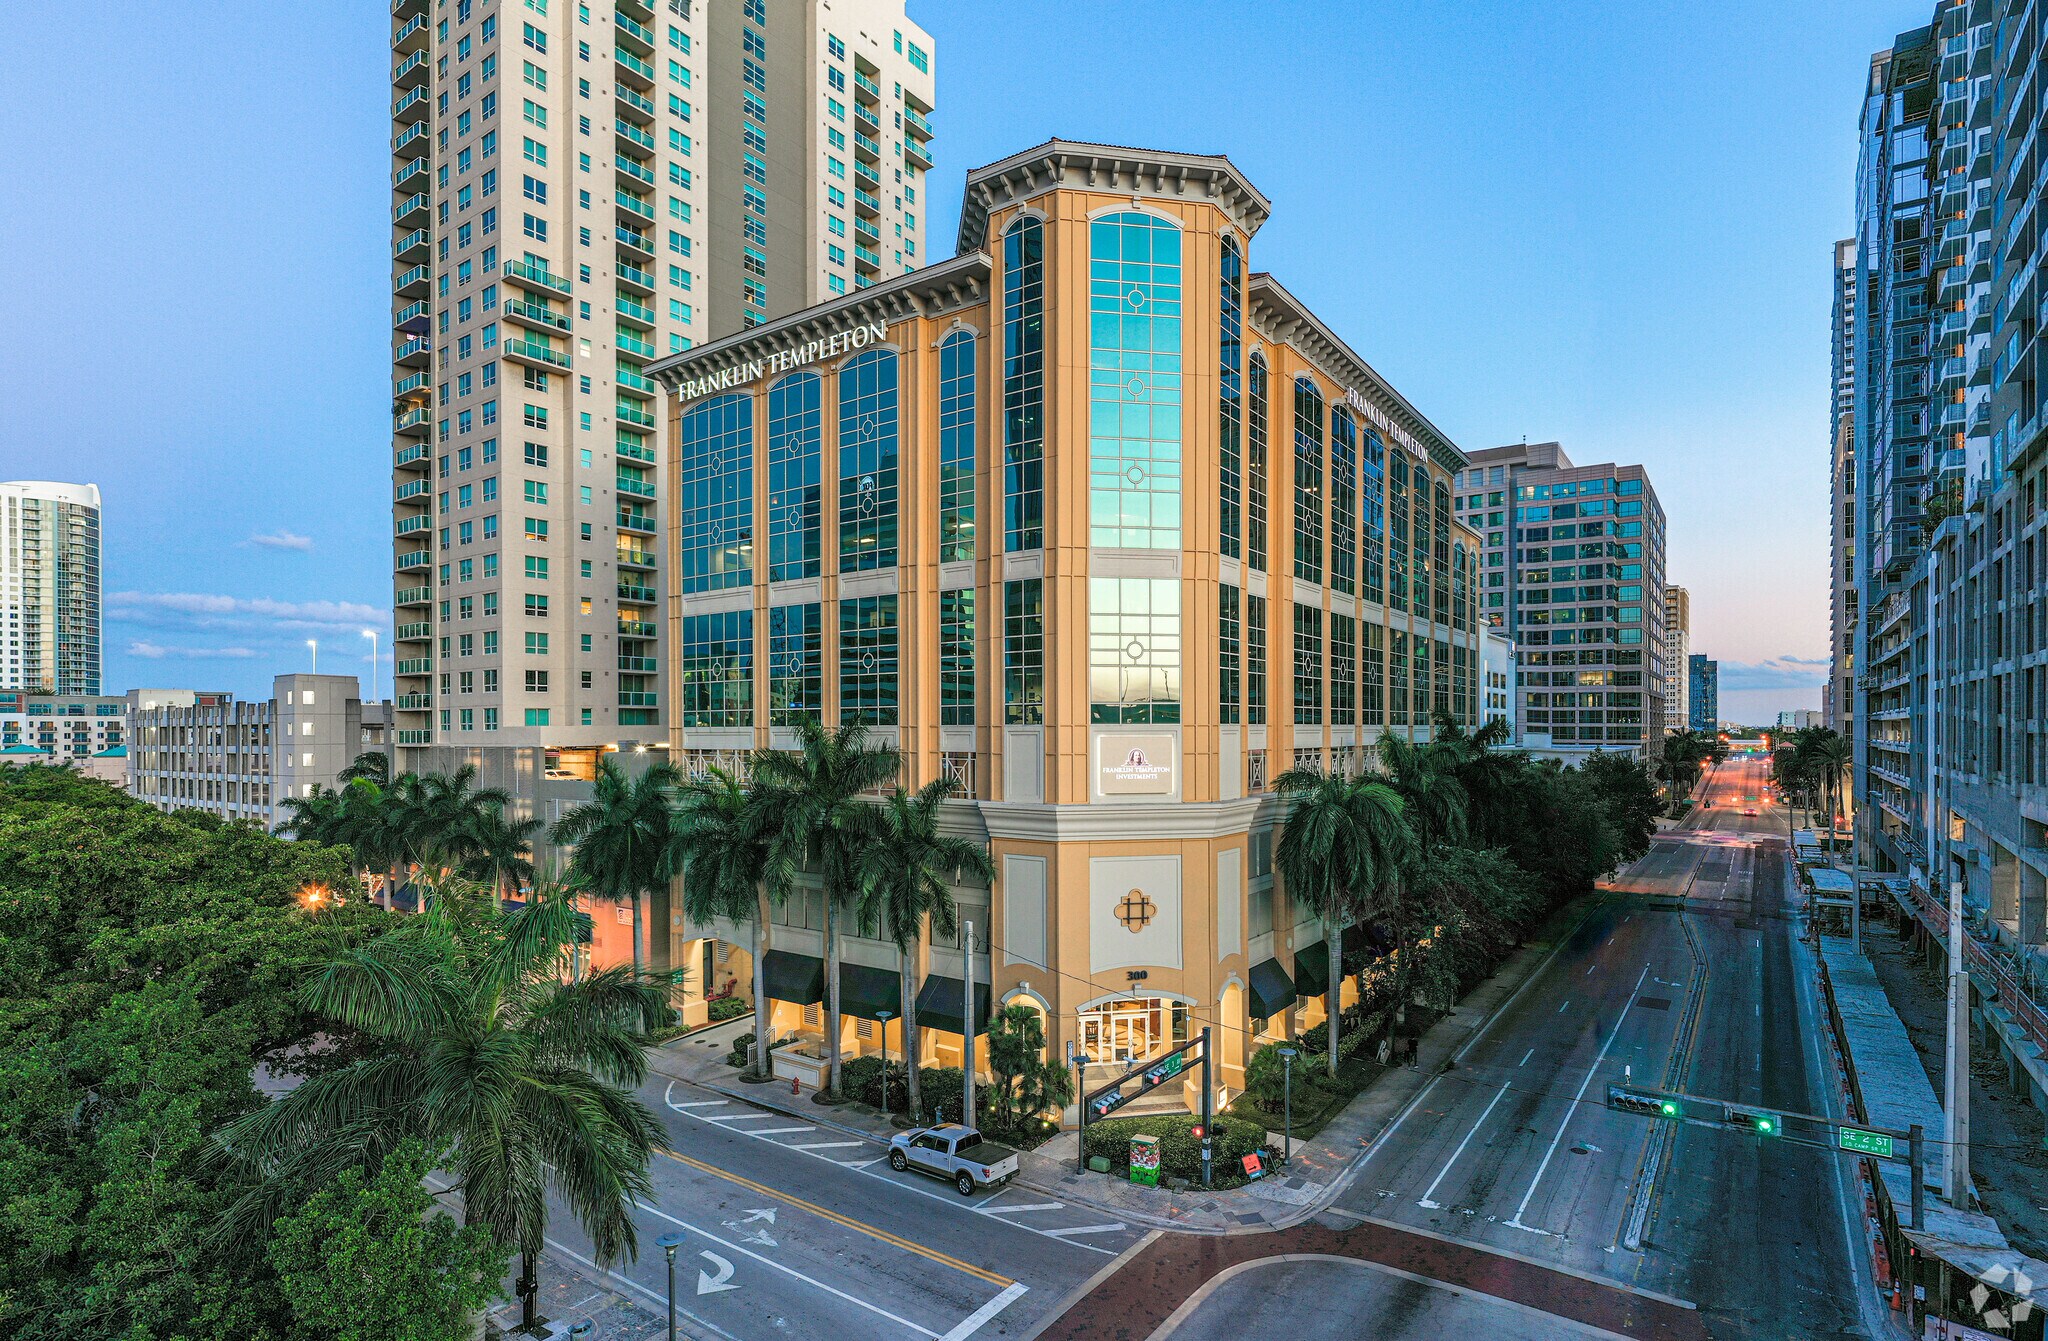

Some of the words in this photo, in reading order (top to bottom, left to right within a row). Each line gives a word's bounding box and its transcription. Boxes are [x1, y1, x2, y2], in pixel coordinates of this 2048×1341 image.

[678, 359, 763, 402] FRANKLIN
[767, 319, 887, 374] TEMPLETON
[1348, 386, 1389, 432] FRANKLIN
[1389, 420, 1428, 463] TEMPLETON
[1126, 970, 1148, 980] 300
[1843, 1131, 1856, 1141] SE
[1862, 1135, 1870, 1143] 2
[1875, 1137, 1888, 1147] ST
